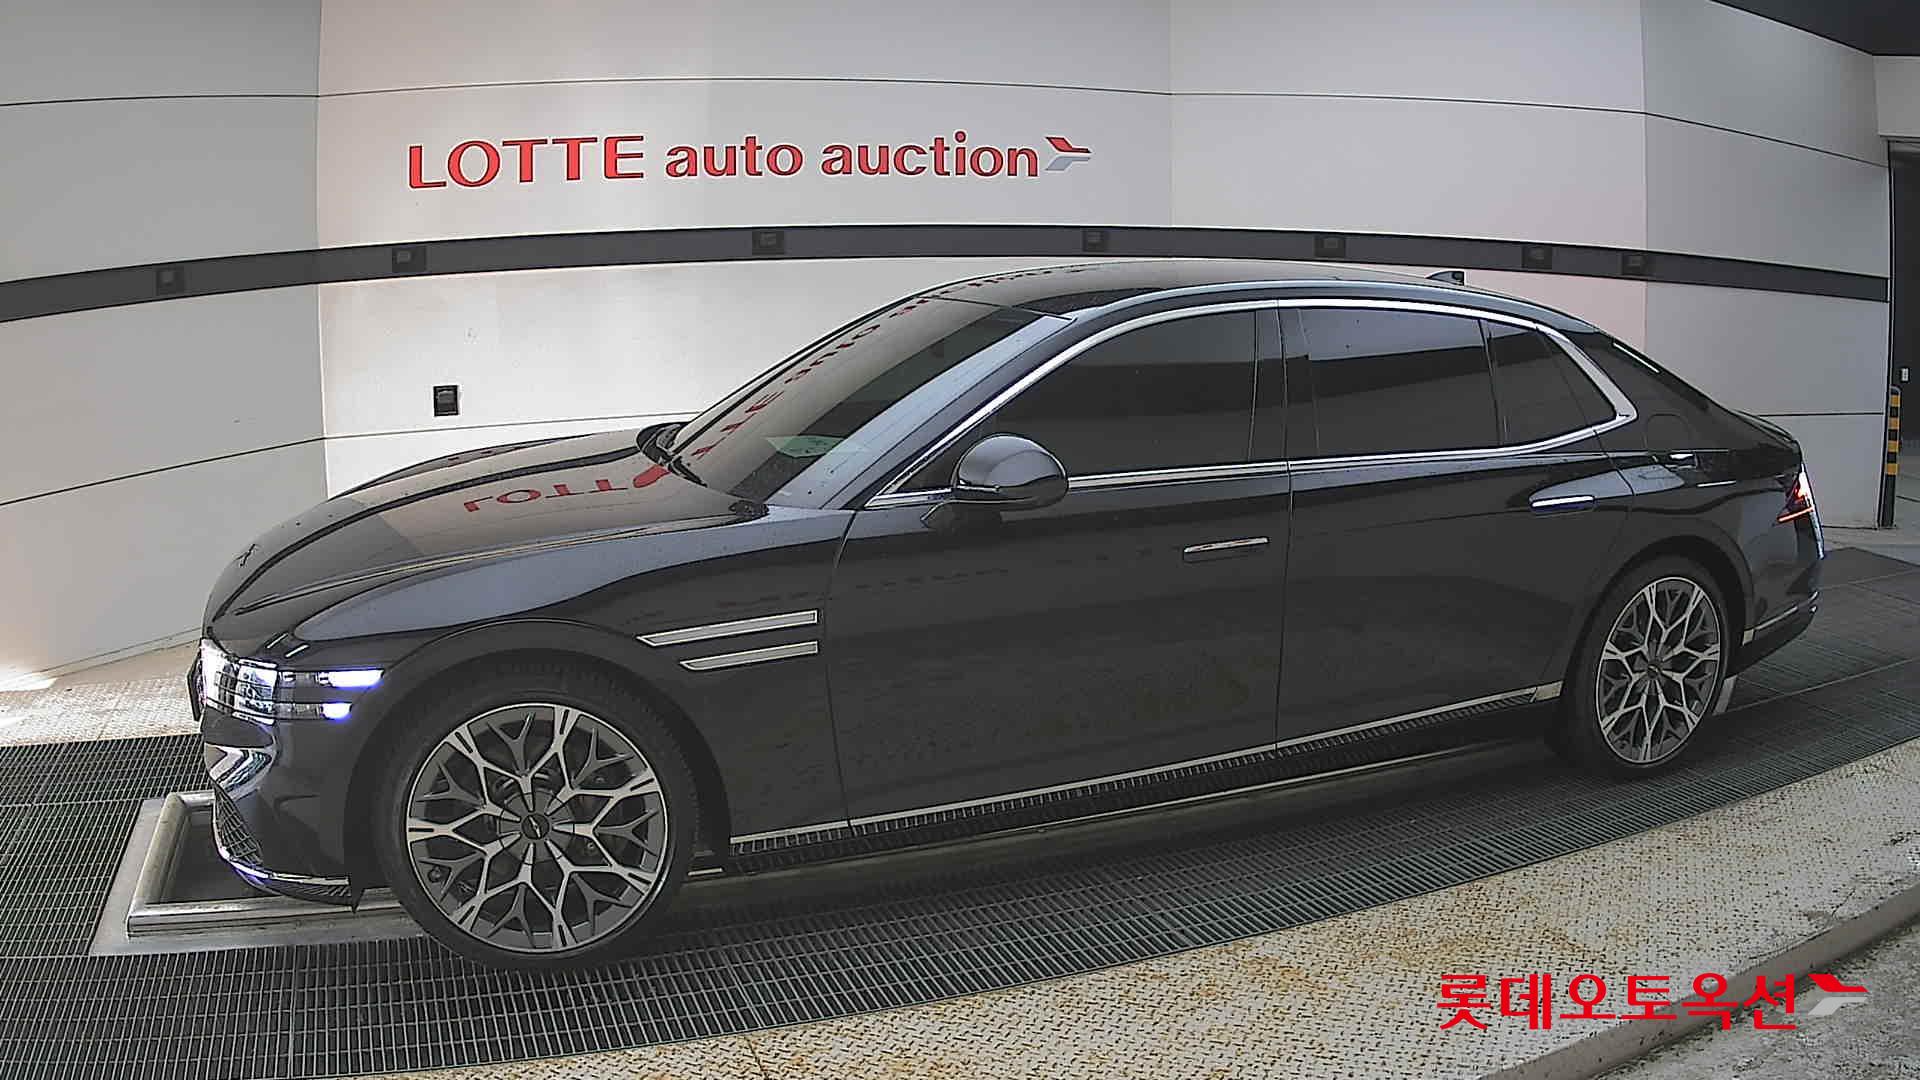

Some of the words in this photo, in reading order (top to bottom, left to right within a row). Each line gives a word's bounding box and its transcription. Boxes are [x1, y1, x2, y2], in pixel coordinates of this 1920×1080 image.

[408, 135, 645, 189] LOTTE
[665, 136, 803, 178] auto
[821, 130, 1038, 177] auction
